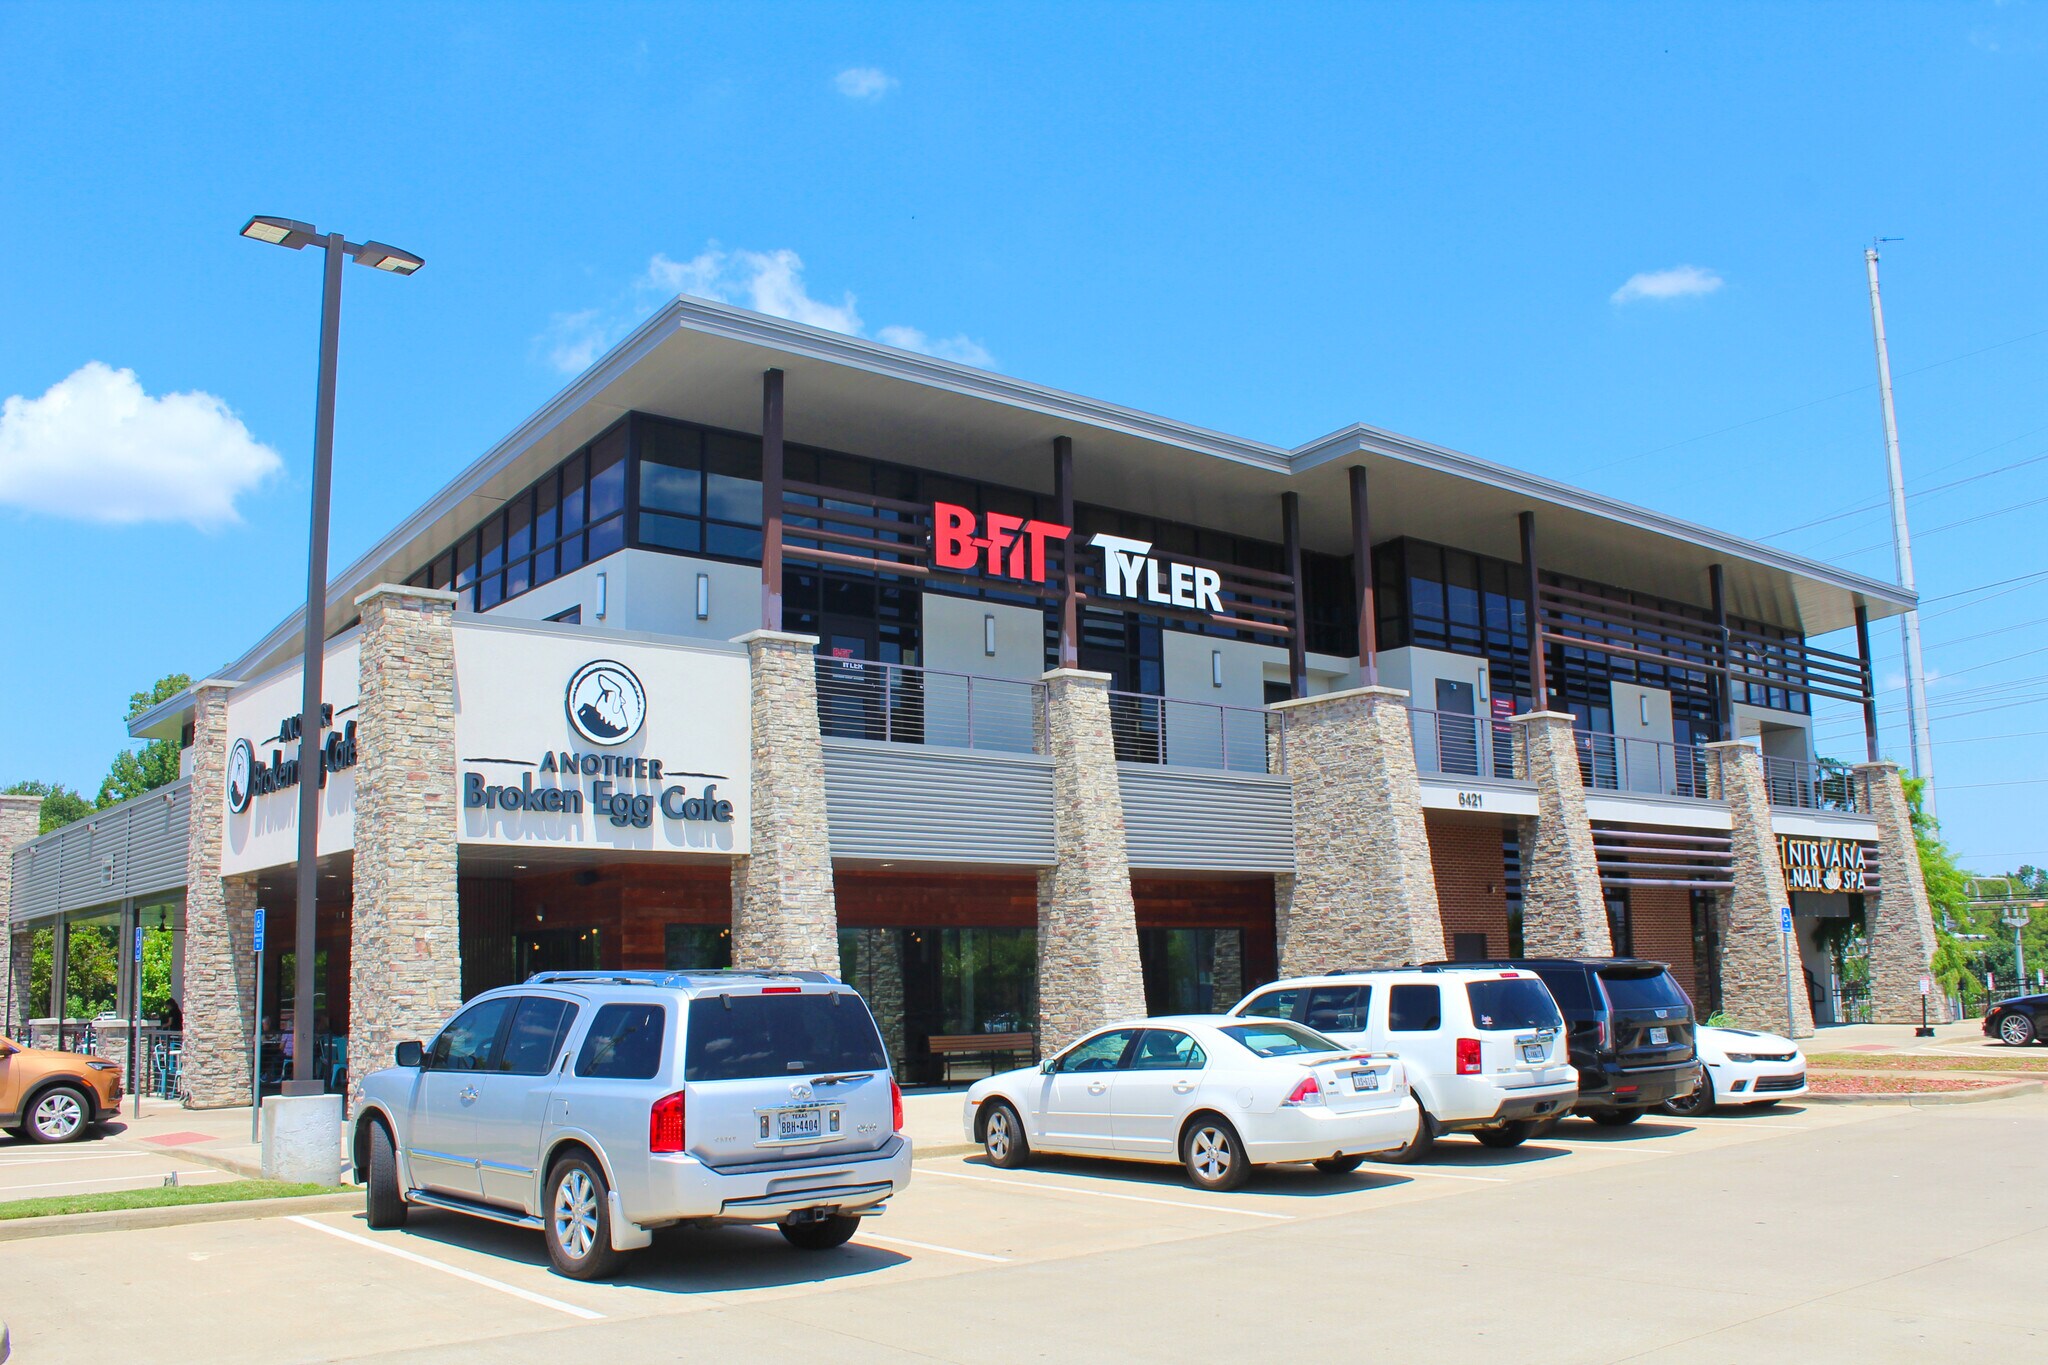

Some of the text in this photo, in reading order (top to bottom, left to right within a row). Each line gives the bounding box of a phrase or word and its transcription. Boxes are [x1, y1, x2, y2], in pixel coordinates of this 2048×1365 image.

[1087, 532, 1224, 612] TYLER
[252, 749, 300, 797] Broken
[326, 719, 358, 773] Cafe
[539, 750, 664, 780] ANOTHER
[464, 772, 735, 828] Broken Egg Cafe
[1458, 791, 1483, 809] 6421
[1787, 841, 1866, 870] NIRVANA
[1792, 866, 1867, 890] NAIL SPA
